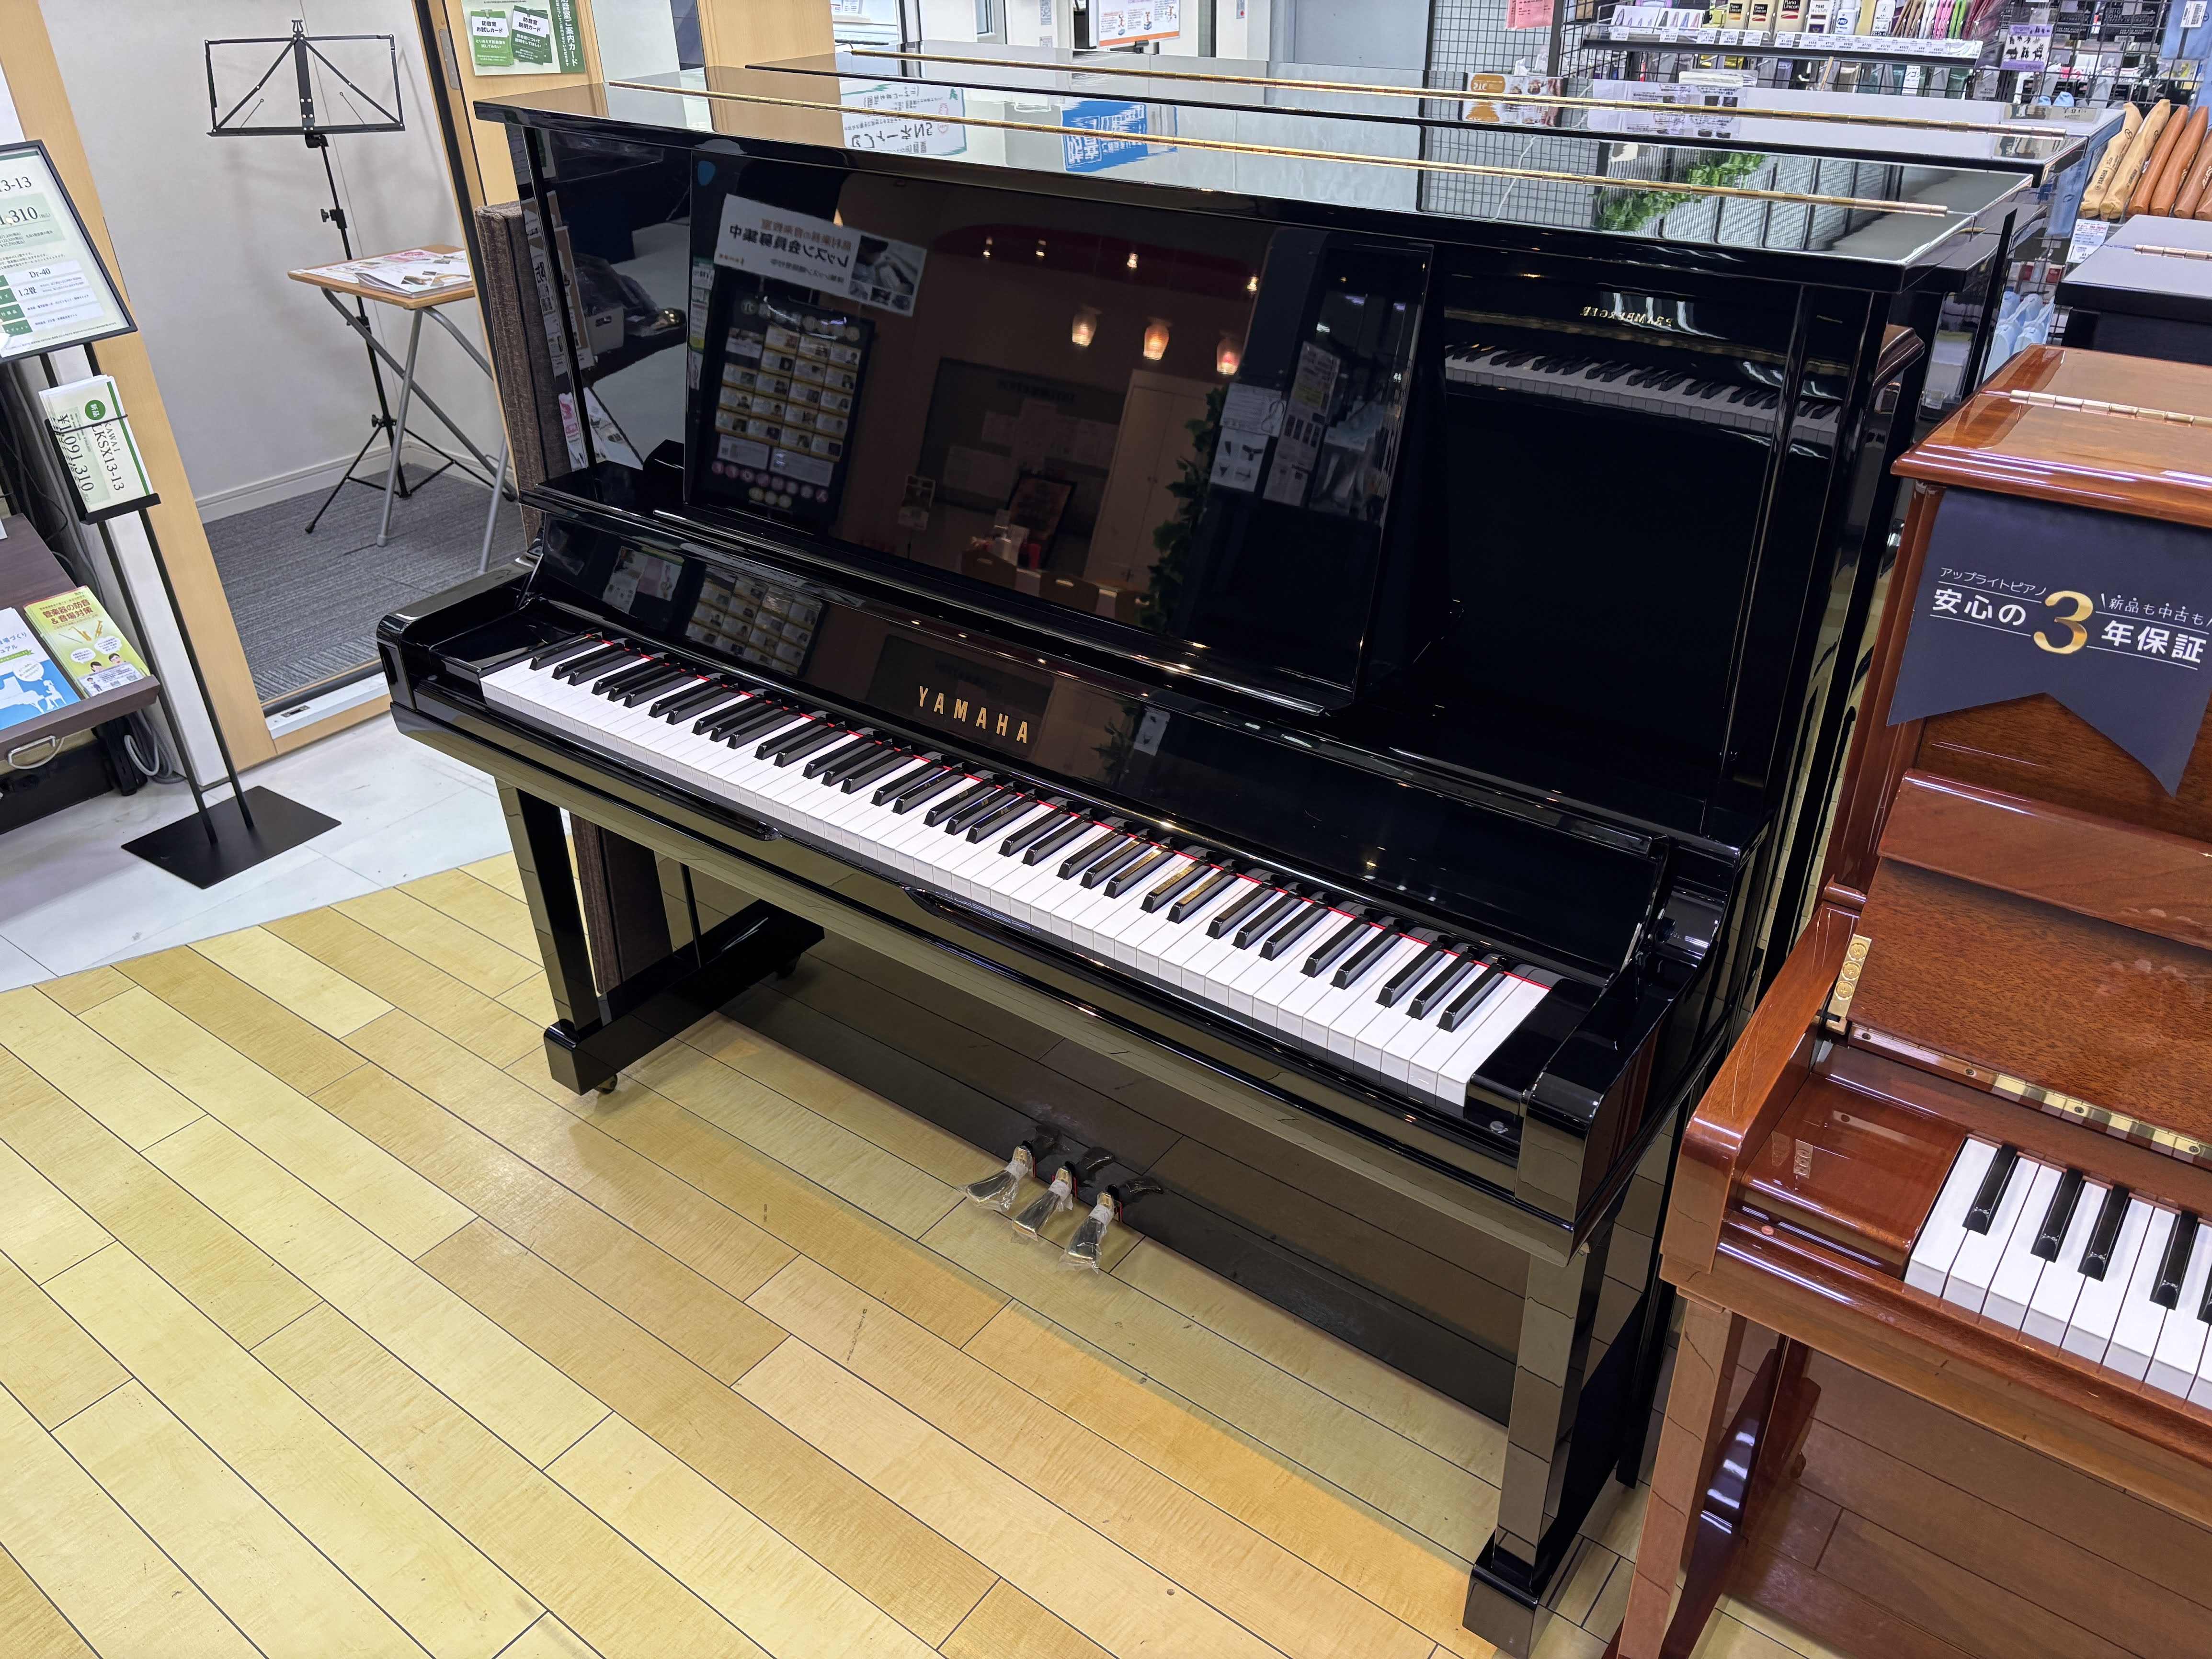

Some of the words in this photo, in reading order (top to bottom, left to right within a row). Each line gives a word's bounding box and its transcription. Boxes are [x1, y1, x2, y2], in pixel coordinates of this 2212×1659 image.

[518, 22, 541, 32] 説明カード
[523, 17, 538, 25] 防音室
[29, 268, 51, 278] Dr-40
[90, 403, 100, 418] 新品
[104, 421, 121, 452] KAWAI
[1940, 567, 2047, 596] アップライトピアノ
[43, 599, 91, 618] 管楽器の防音
[2109, 597, 2204, 625] 新品も中古も
[919, 685, 1028, 744] YAMAHA
